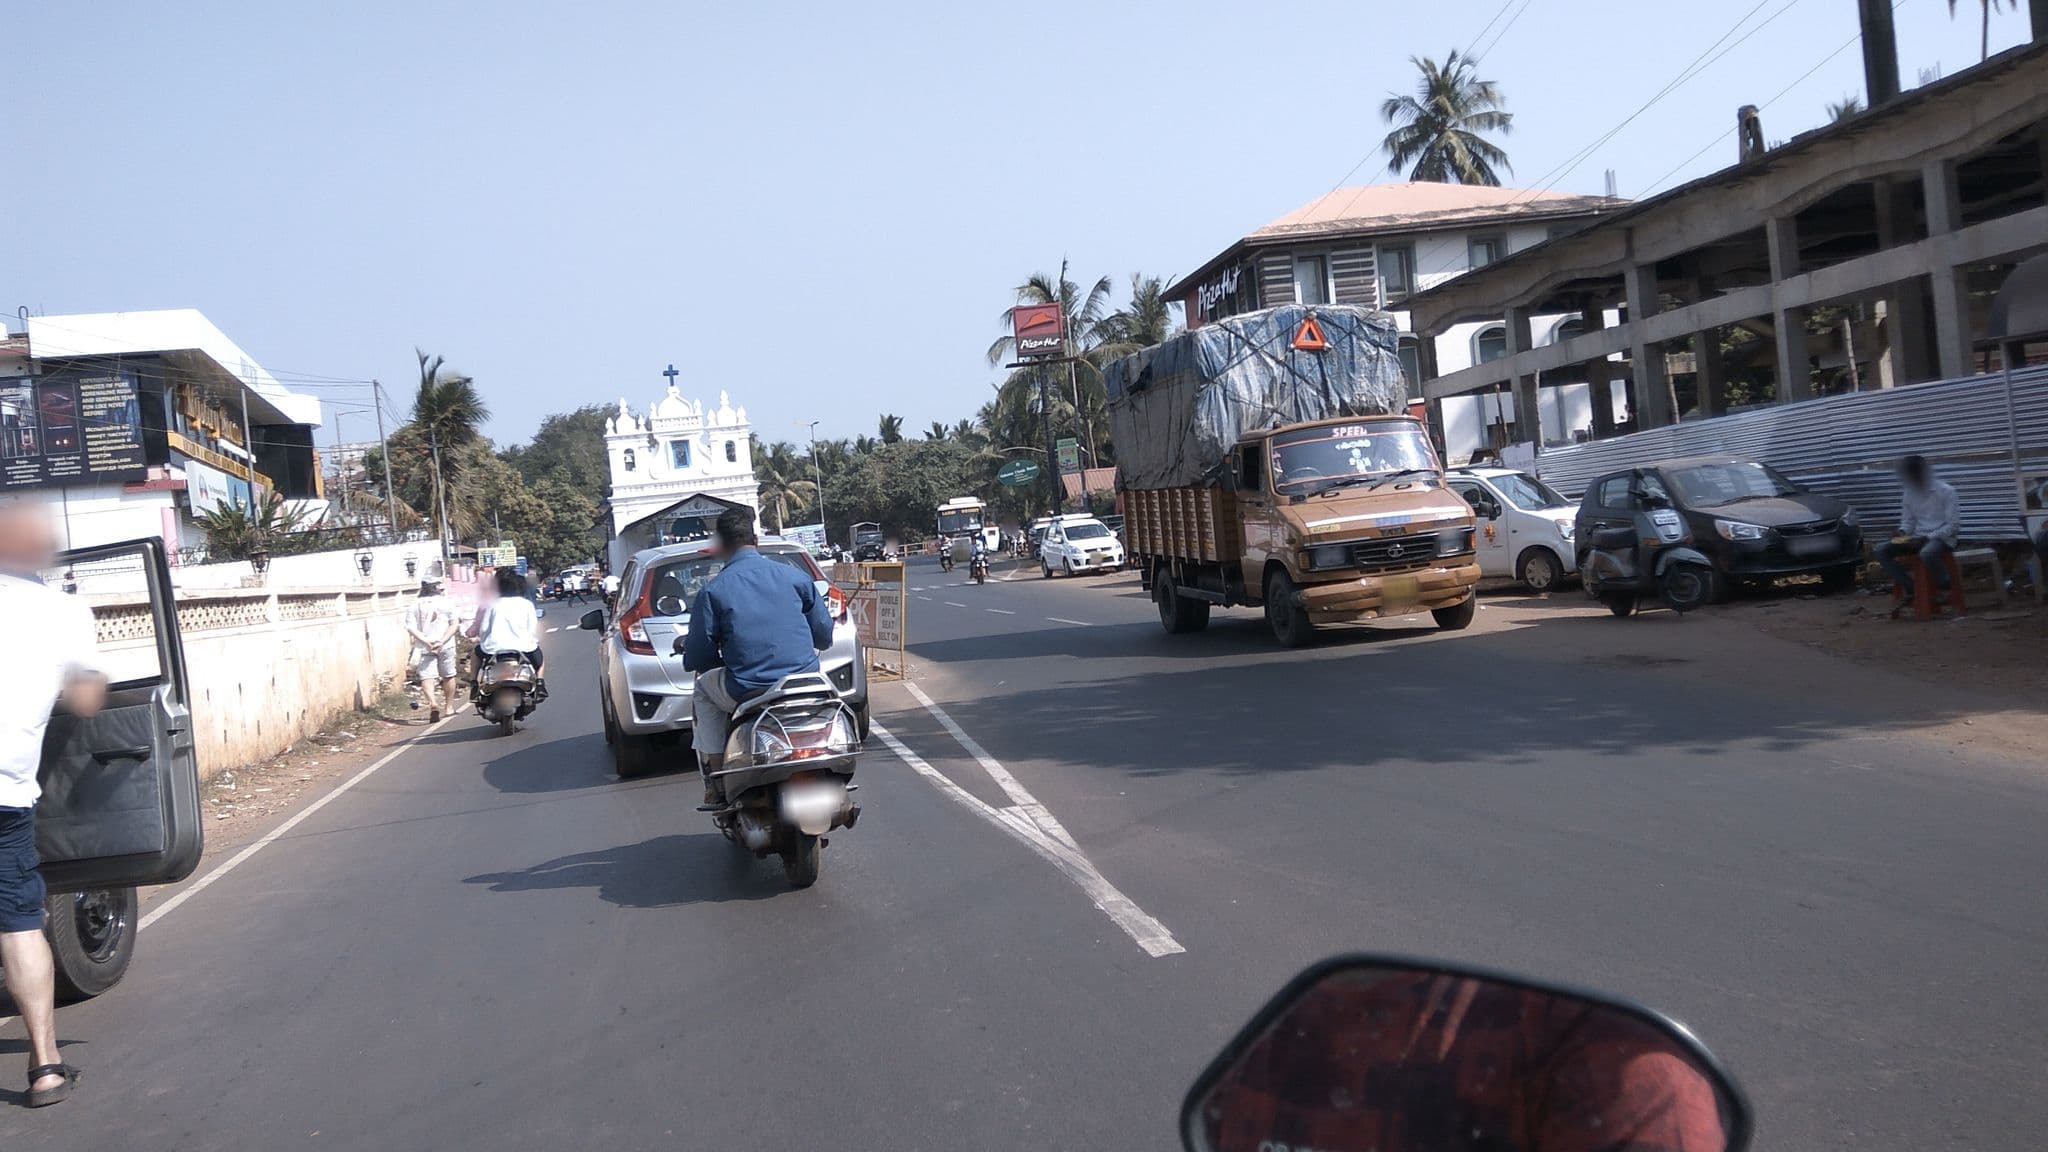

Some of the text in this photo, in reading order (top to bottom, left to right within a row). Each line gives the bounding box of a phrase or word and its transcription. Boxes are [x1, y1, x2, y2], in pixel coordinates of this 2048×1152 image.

[1198, 266, 1242, 319] Pizza Hut
[1020, 337, 1060, 350] Pizza Hut
[1379, 525, 1407, 537] TATA
[881, 608, 890, 617] OFF
